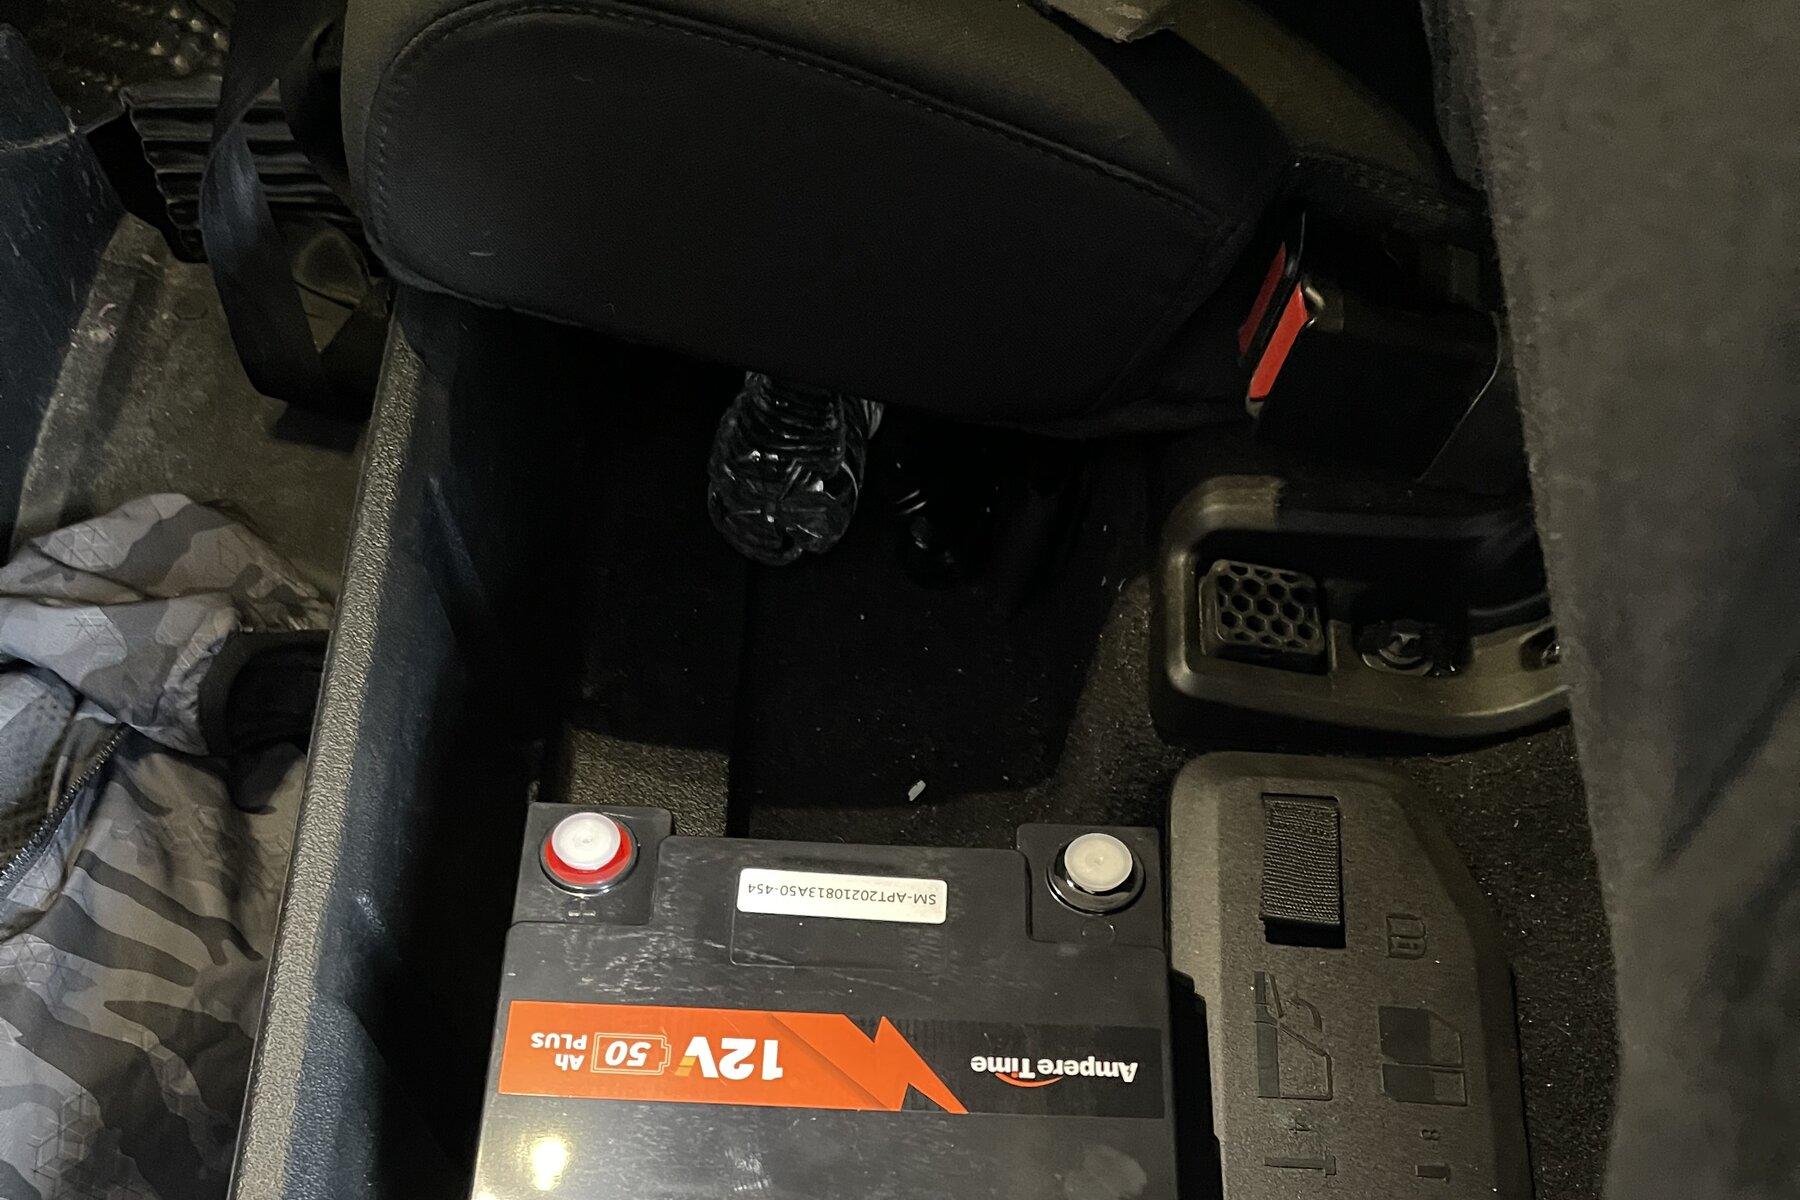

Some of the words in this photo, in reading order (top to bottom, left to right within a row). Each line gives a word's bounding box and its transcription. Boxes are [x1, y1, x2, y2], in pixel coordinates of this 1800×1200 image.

[747, 882, 937, 906] SM-APT20210813A50-454
[530, 1032, 588, 1050] PLUS
[603, 1040, 651, 1067] 50
[555, 1053, 585, 1071] Ah
[675, 1036, 784, 1081] 12V
[970, 1054, 1037, 1079] Time
[1037, 1057, 1139, 1083] Ampere
